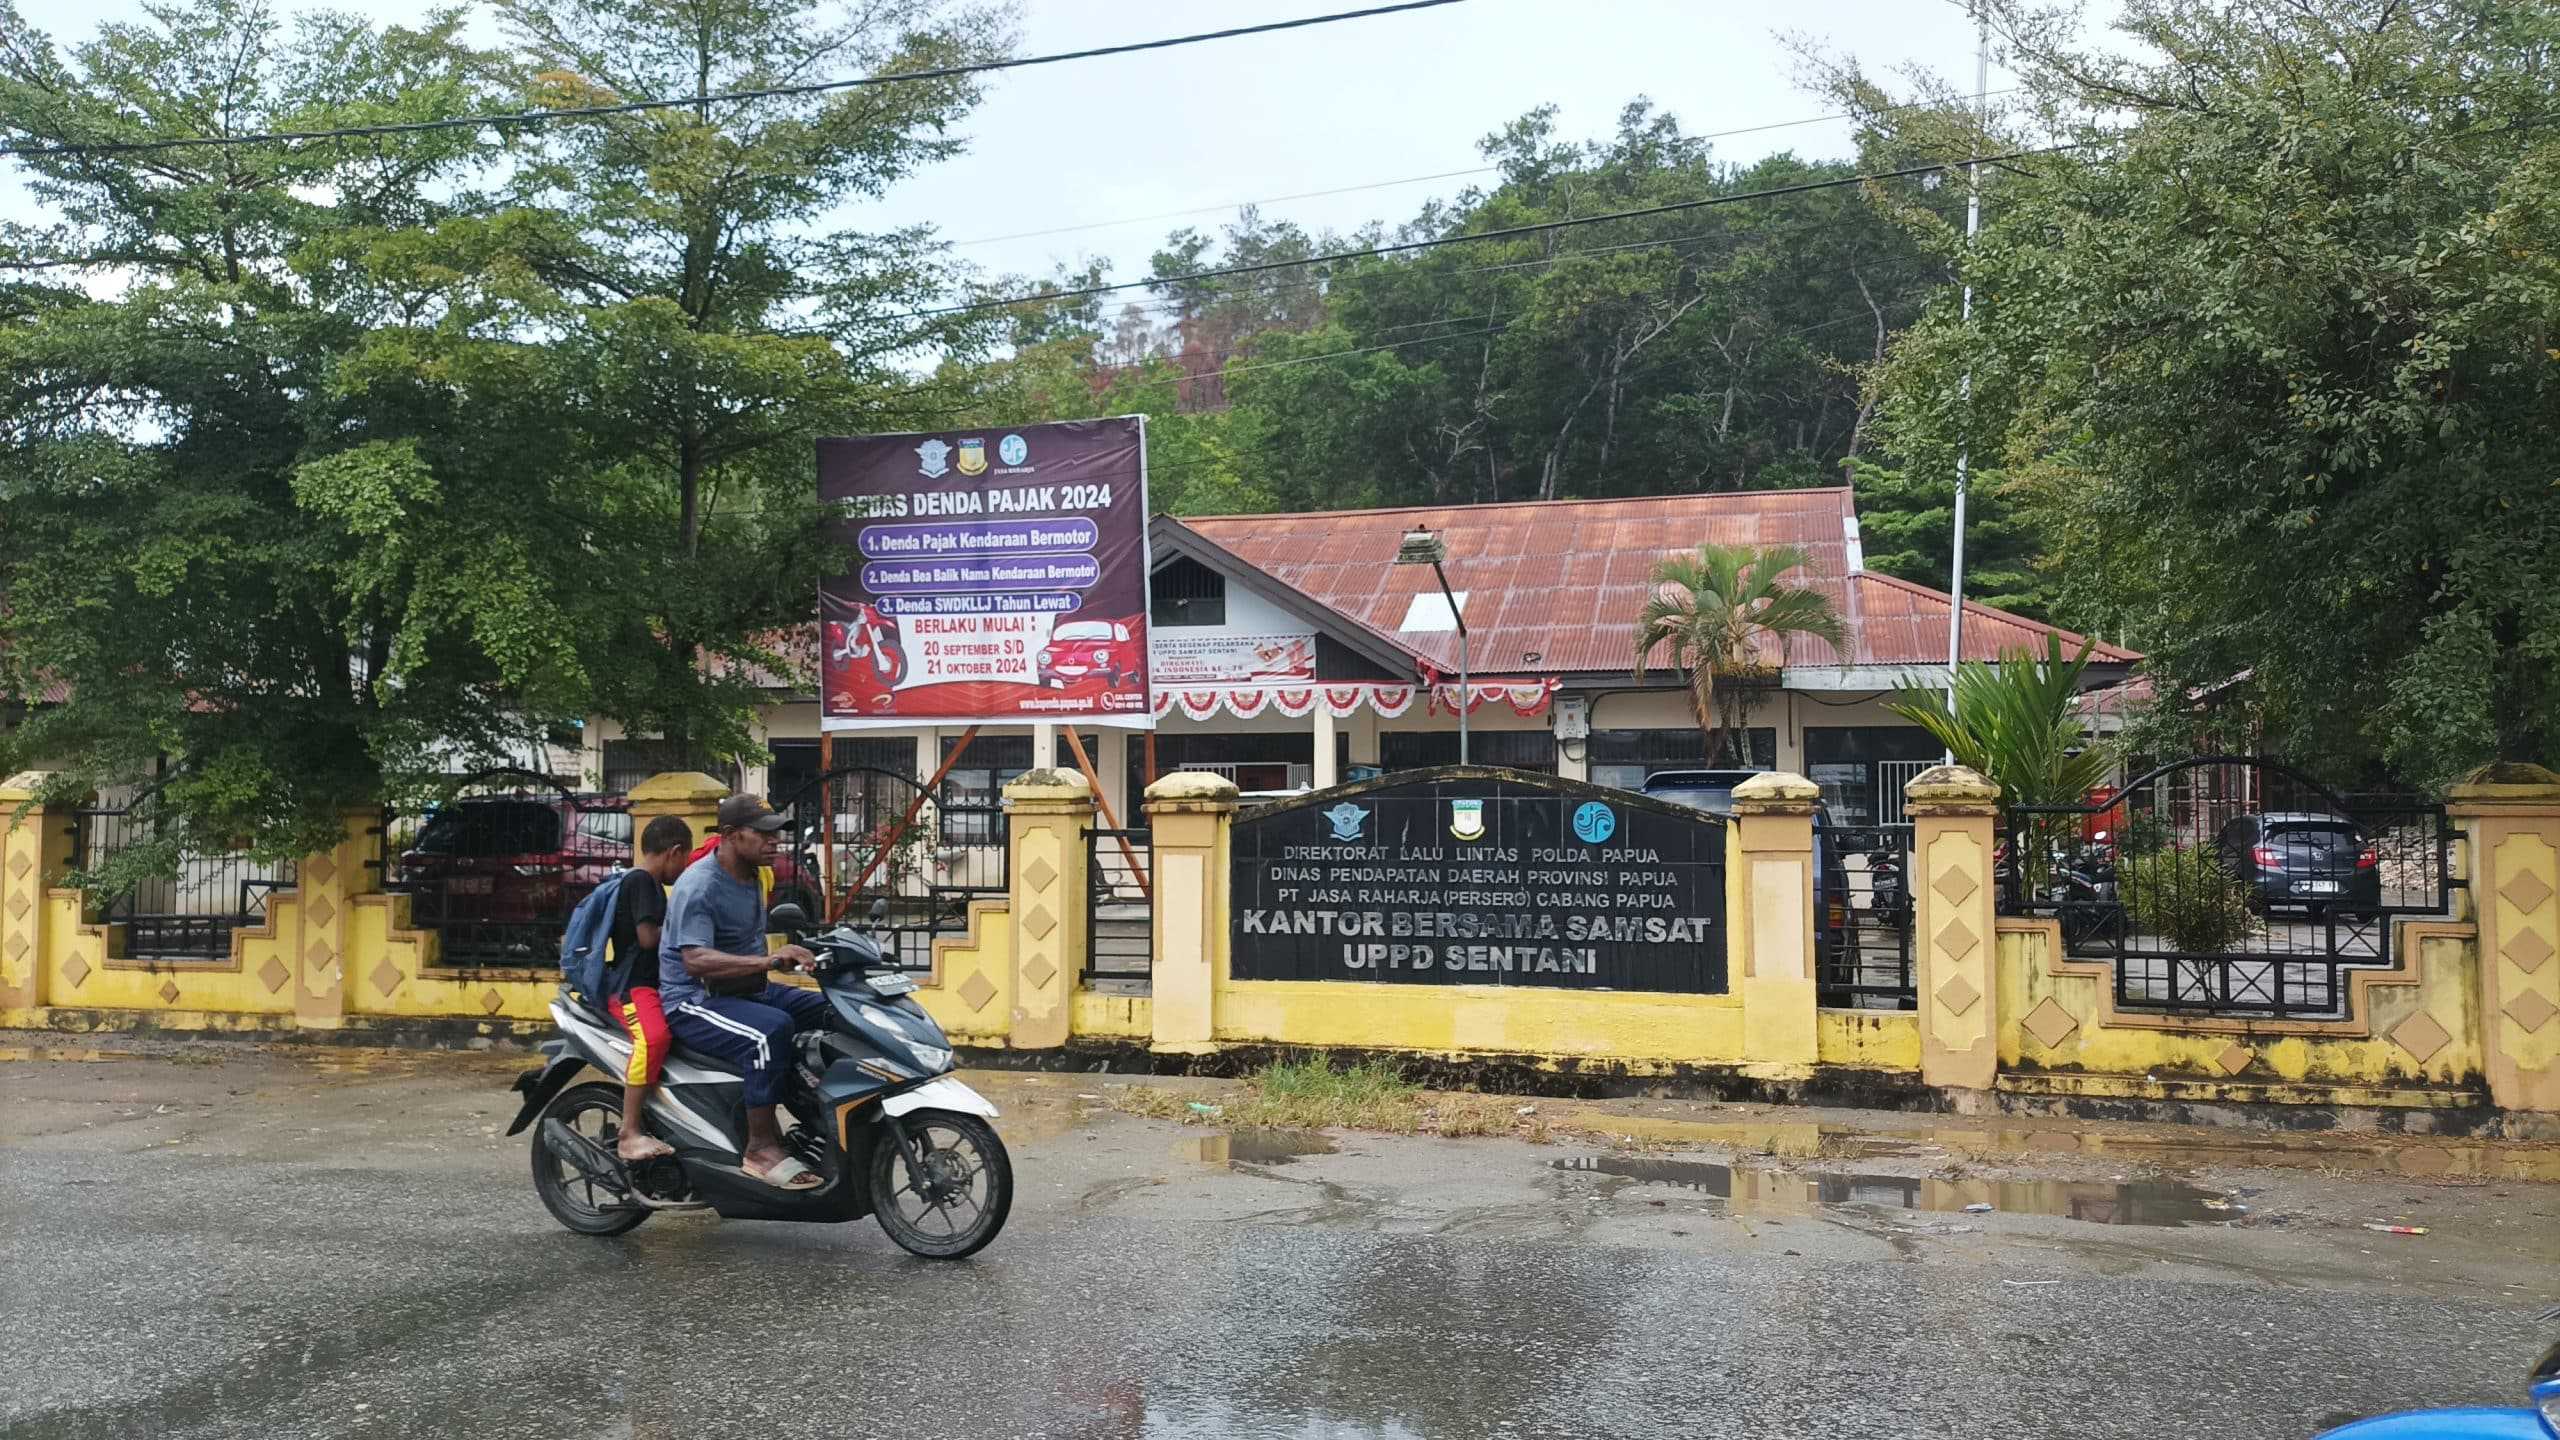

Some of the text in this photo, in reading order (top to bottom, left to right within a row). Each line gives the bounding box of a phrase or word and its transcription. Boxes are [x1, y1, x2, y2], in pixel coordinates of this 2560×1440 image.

[913, 492, 983, 516] DENDA
[988, 487, 1056, 514] PAJAK
[1061, 484, 1112, 509] 2024
[867, 529, 1092, 553] 1. Denda Pajak Kendaraan Bermotor
[869, 563, 1096, 584] 2. Denda Bea Balik Nama Kendaraan Bermotor
[882, 595, 1071, 613] 3. Denda SWDKLLJ Tahun Lewat
[914, 617, 977, 634] BERLAKU
[983, 616, 1024, 632] MULAI
[924, 640, 1024, 656] 20 SEPTEMBER S/D
[927, 659, 1027, 674] 21 OKTOBER 2024
[1284, 846, 1660, 863] DIREKTORAT LALU LINTAS POLDA PAPUA
[1271, 867, 1321, 881] DINAS
[1331, 868, 1440, 883] PENDAPATAN
[1448, 869, 1520, 883] DAERAH
[1620, 871, 1678, 886] PAPUA
[1278, 888, 1676, 909] PT JASA RAHARJA (PERSERO) CABANG PAPUA
[1242, 909, 1712, 943] KANTOR BERSAMA SAMSAT
[1343, 944, 1597, 974] UPPD SENTANI
